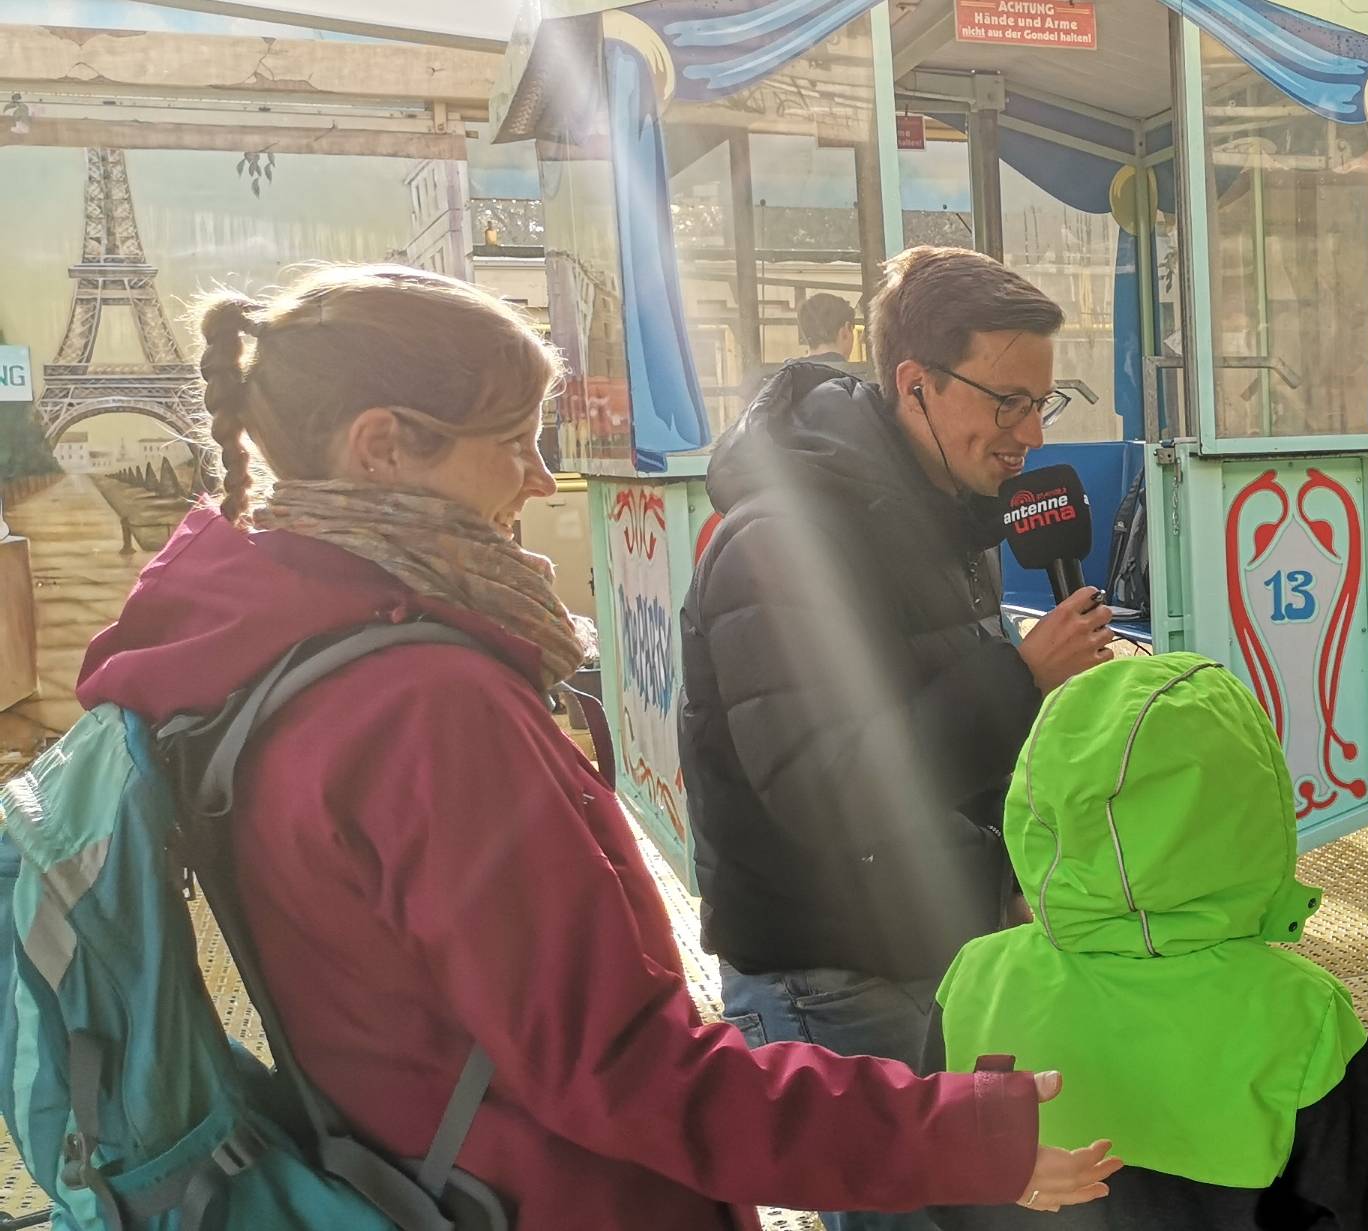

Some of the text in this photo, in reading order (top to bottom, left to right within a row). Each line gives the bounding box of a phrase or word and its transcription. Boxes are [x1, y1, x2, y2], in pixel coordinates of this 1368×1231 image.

[998, 1, 1055, 15] ACHTUNG
[974, 12, 1078, 30] Hände und Arme
[962, 26, 1092, 43] nicht aus der Gondel halten!
[1003, 494, 1068, 525] antenne
[1014, 505, 1077, 534] unna
[1263, 569, 1316, 621] 13
